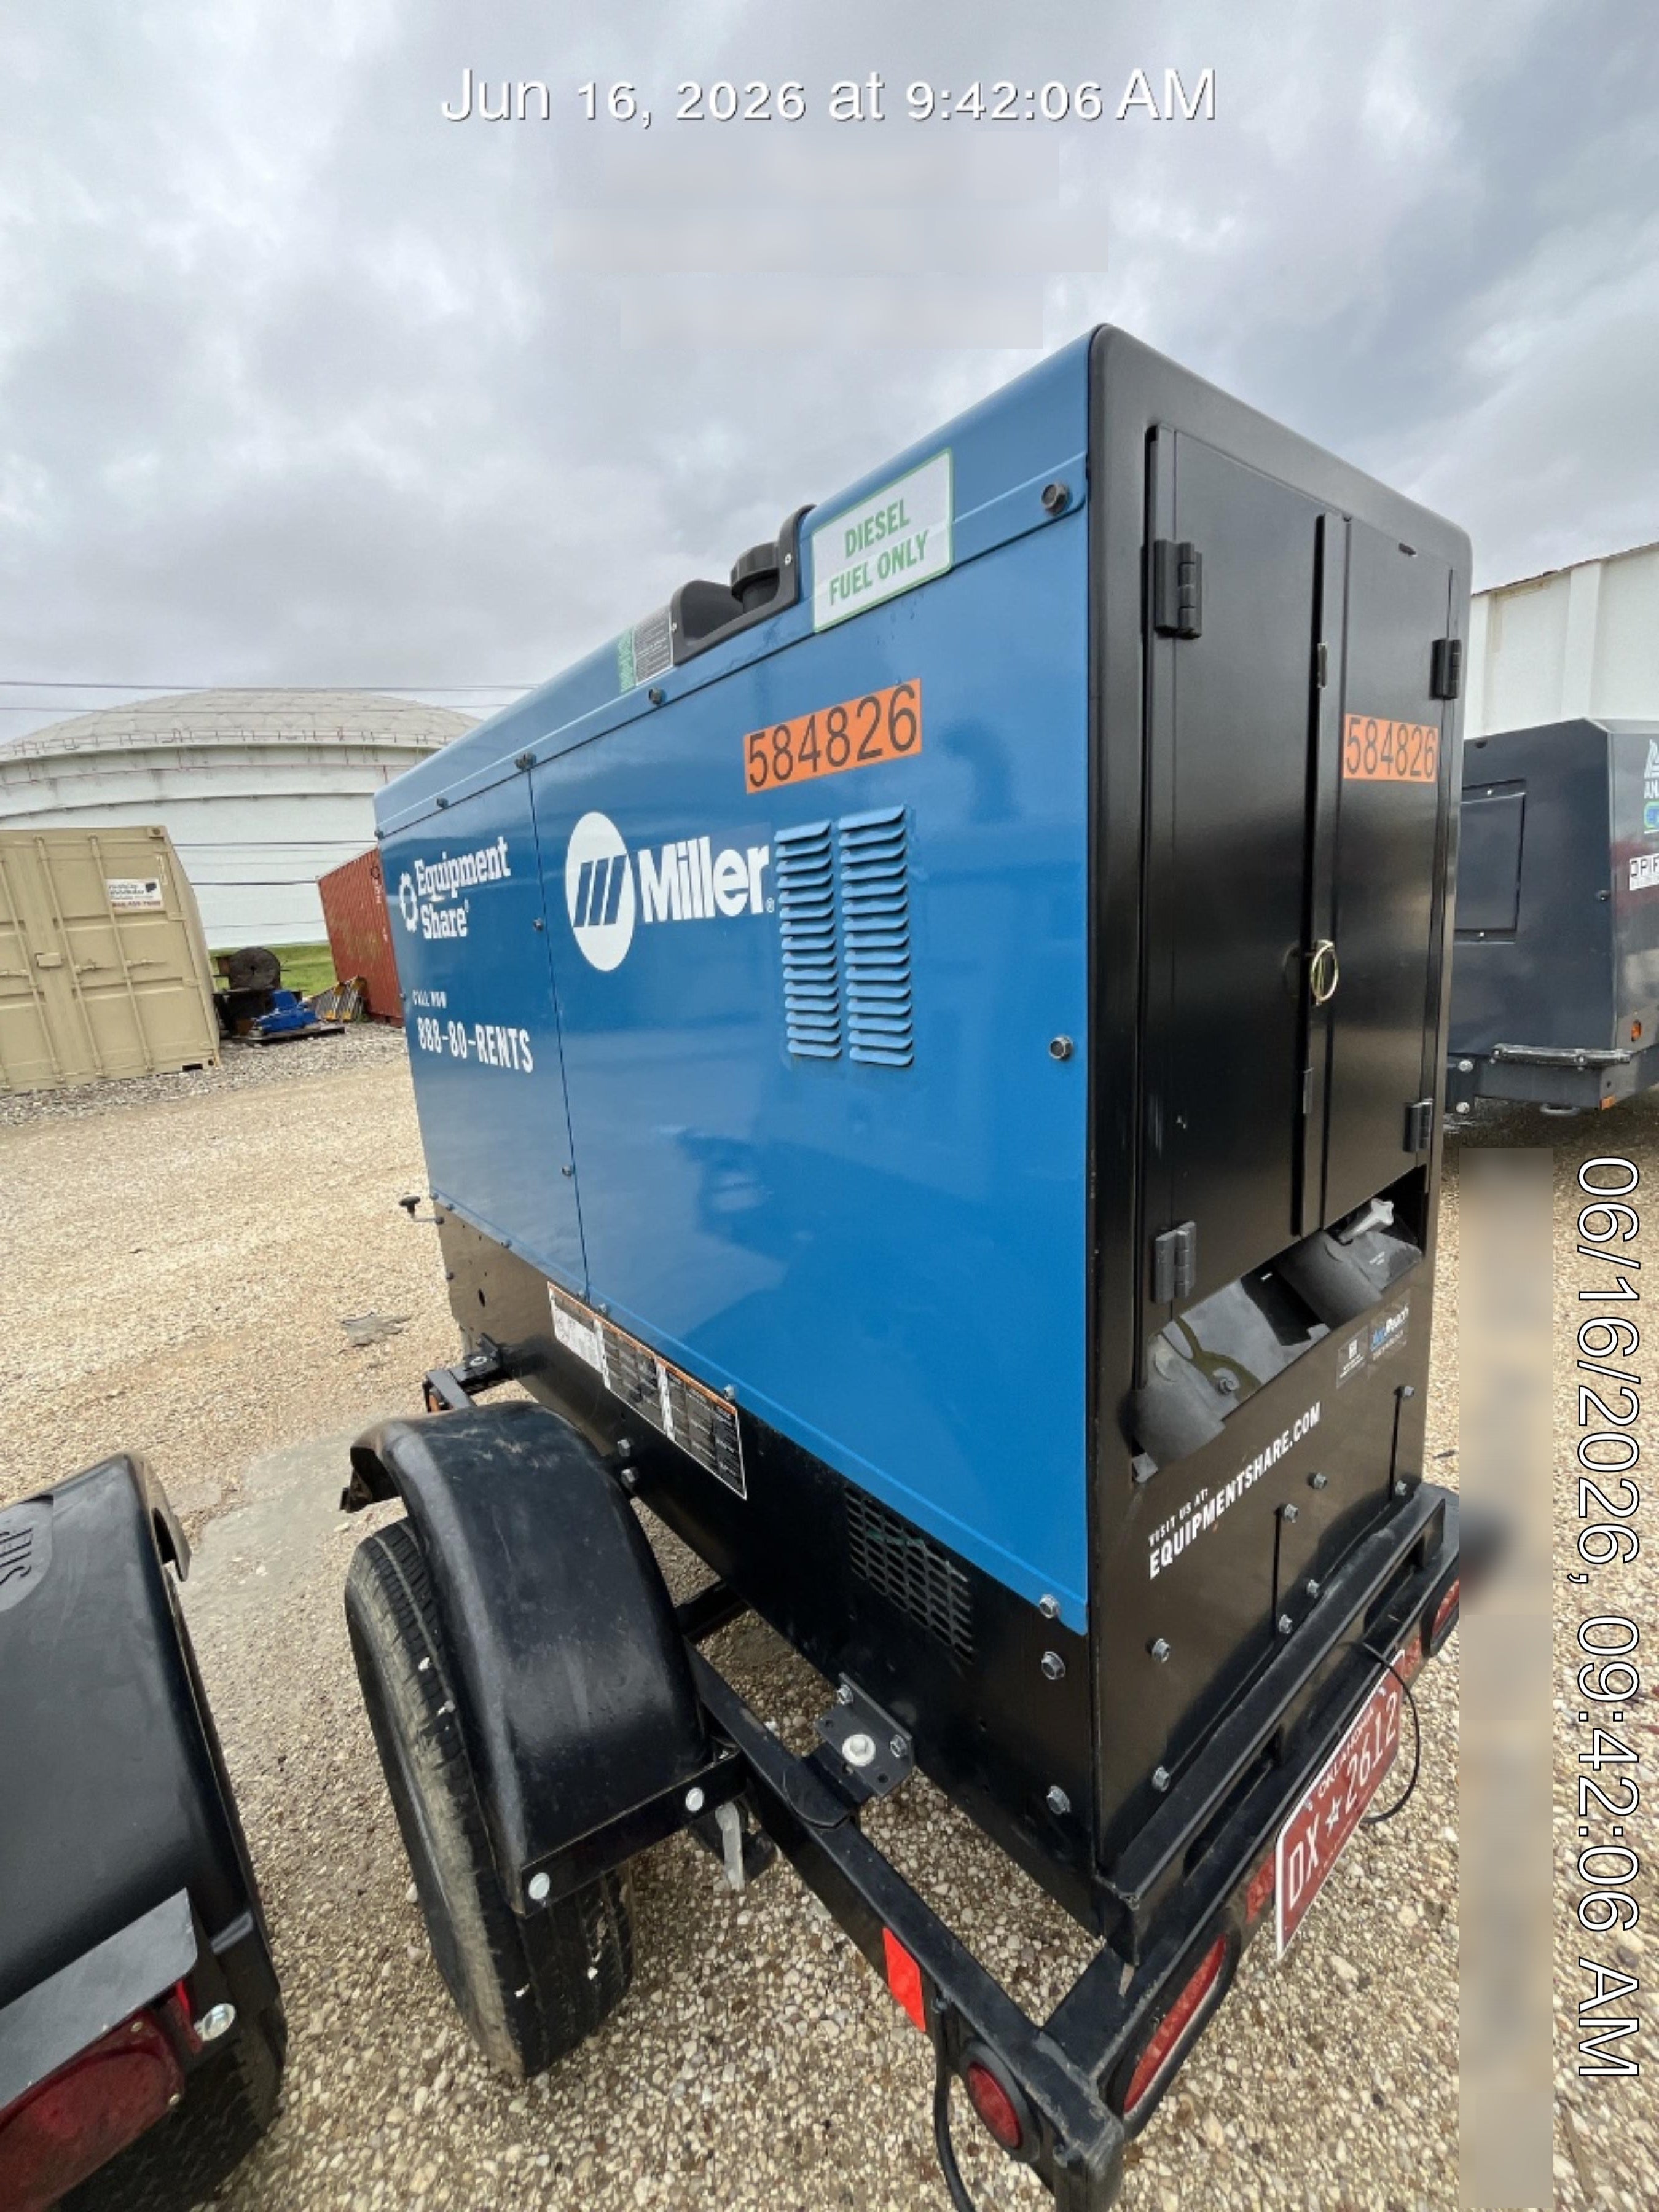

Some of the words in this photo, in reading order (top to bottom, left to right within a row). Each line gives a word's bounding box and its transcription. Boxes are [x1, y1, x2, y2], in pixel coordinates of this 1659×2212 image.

[844, 498, 910, 559] DIESEL
[830, 561, 873, 605] FUEL
[877, 529, 928, 579] ONLY
[749, 684, 917, 788] 584826
[1347, 717, 1437, 778] 584826
[414, 834, 511, 898] Equipment
[637, 836, 769, 923] Miller
[420, 903, 468, 939] Share
[417, 1016, 533, 1073] 888-80-RENTS
[1148, 1514, 1175, 1547] VISIT
[1179, 1502, 1192, 1520] US
[1150, 1400, 1321, 1580] EQUIPMENTSHARE.COM
[1317, 1707, 1376, 1799] OKLAHOMA
[1345, 1691, 1398, 1814] 2612
